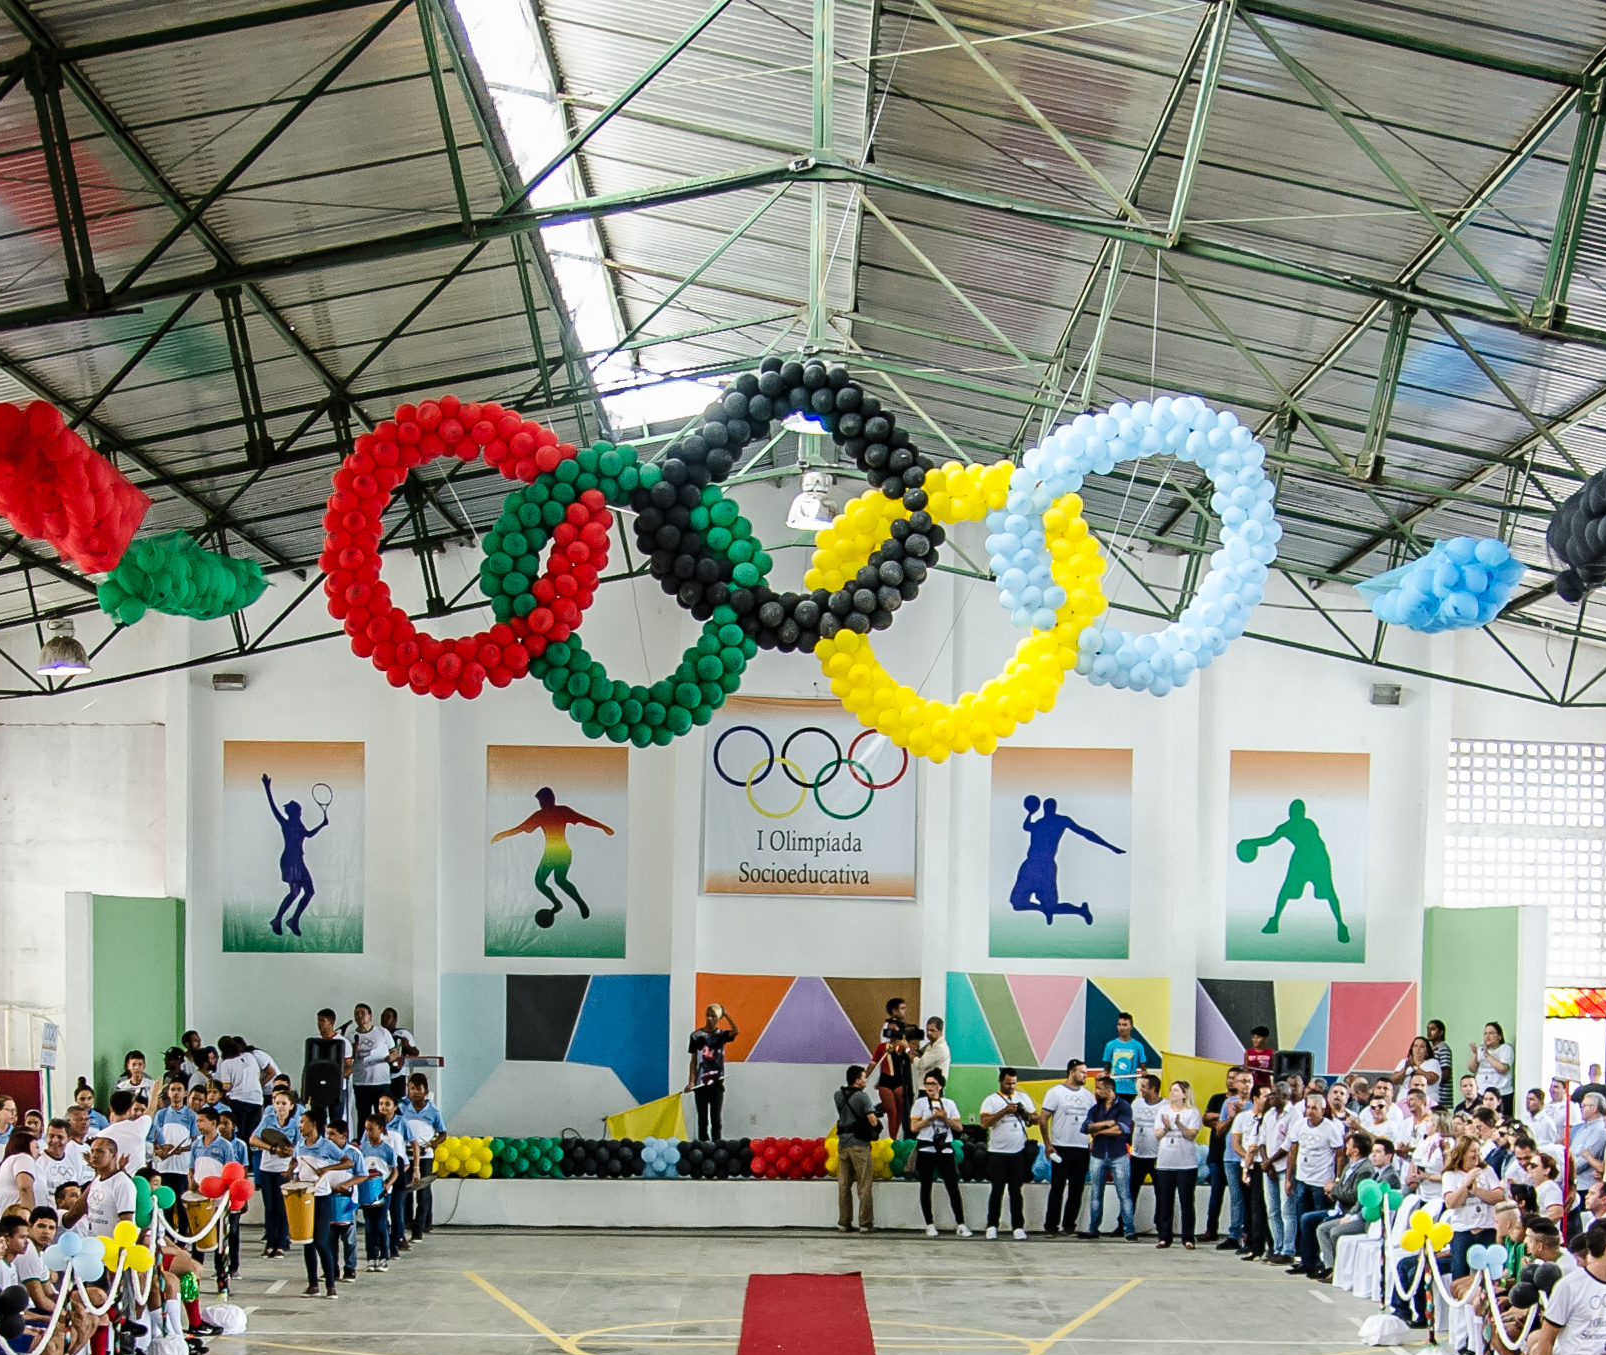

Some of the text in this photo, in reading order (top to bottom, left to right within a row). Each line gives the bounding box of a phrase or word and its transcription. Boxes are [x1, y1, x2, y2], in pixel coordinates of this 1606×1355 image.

[756, 830, 863, 857] I Olimpíada
[739, 862, 870, 885] Socioeducativa
